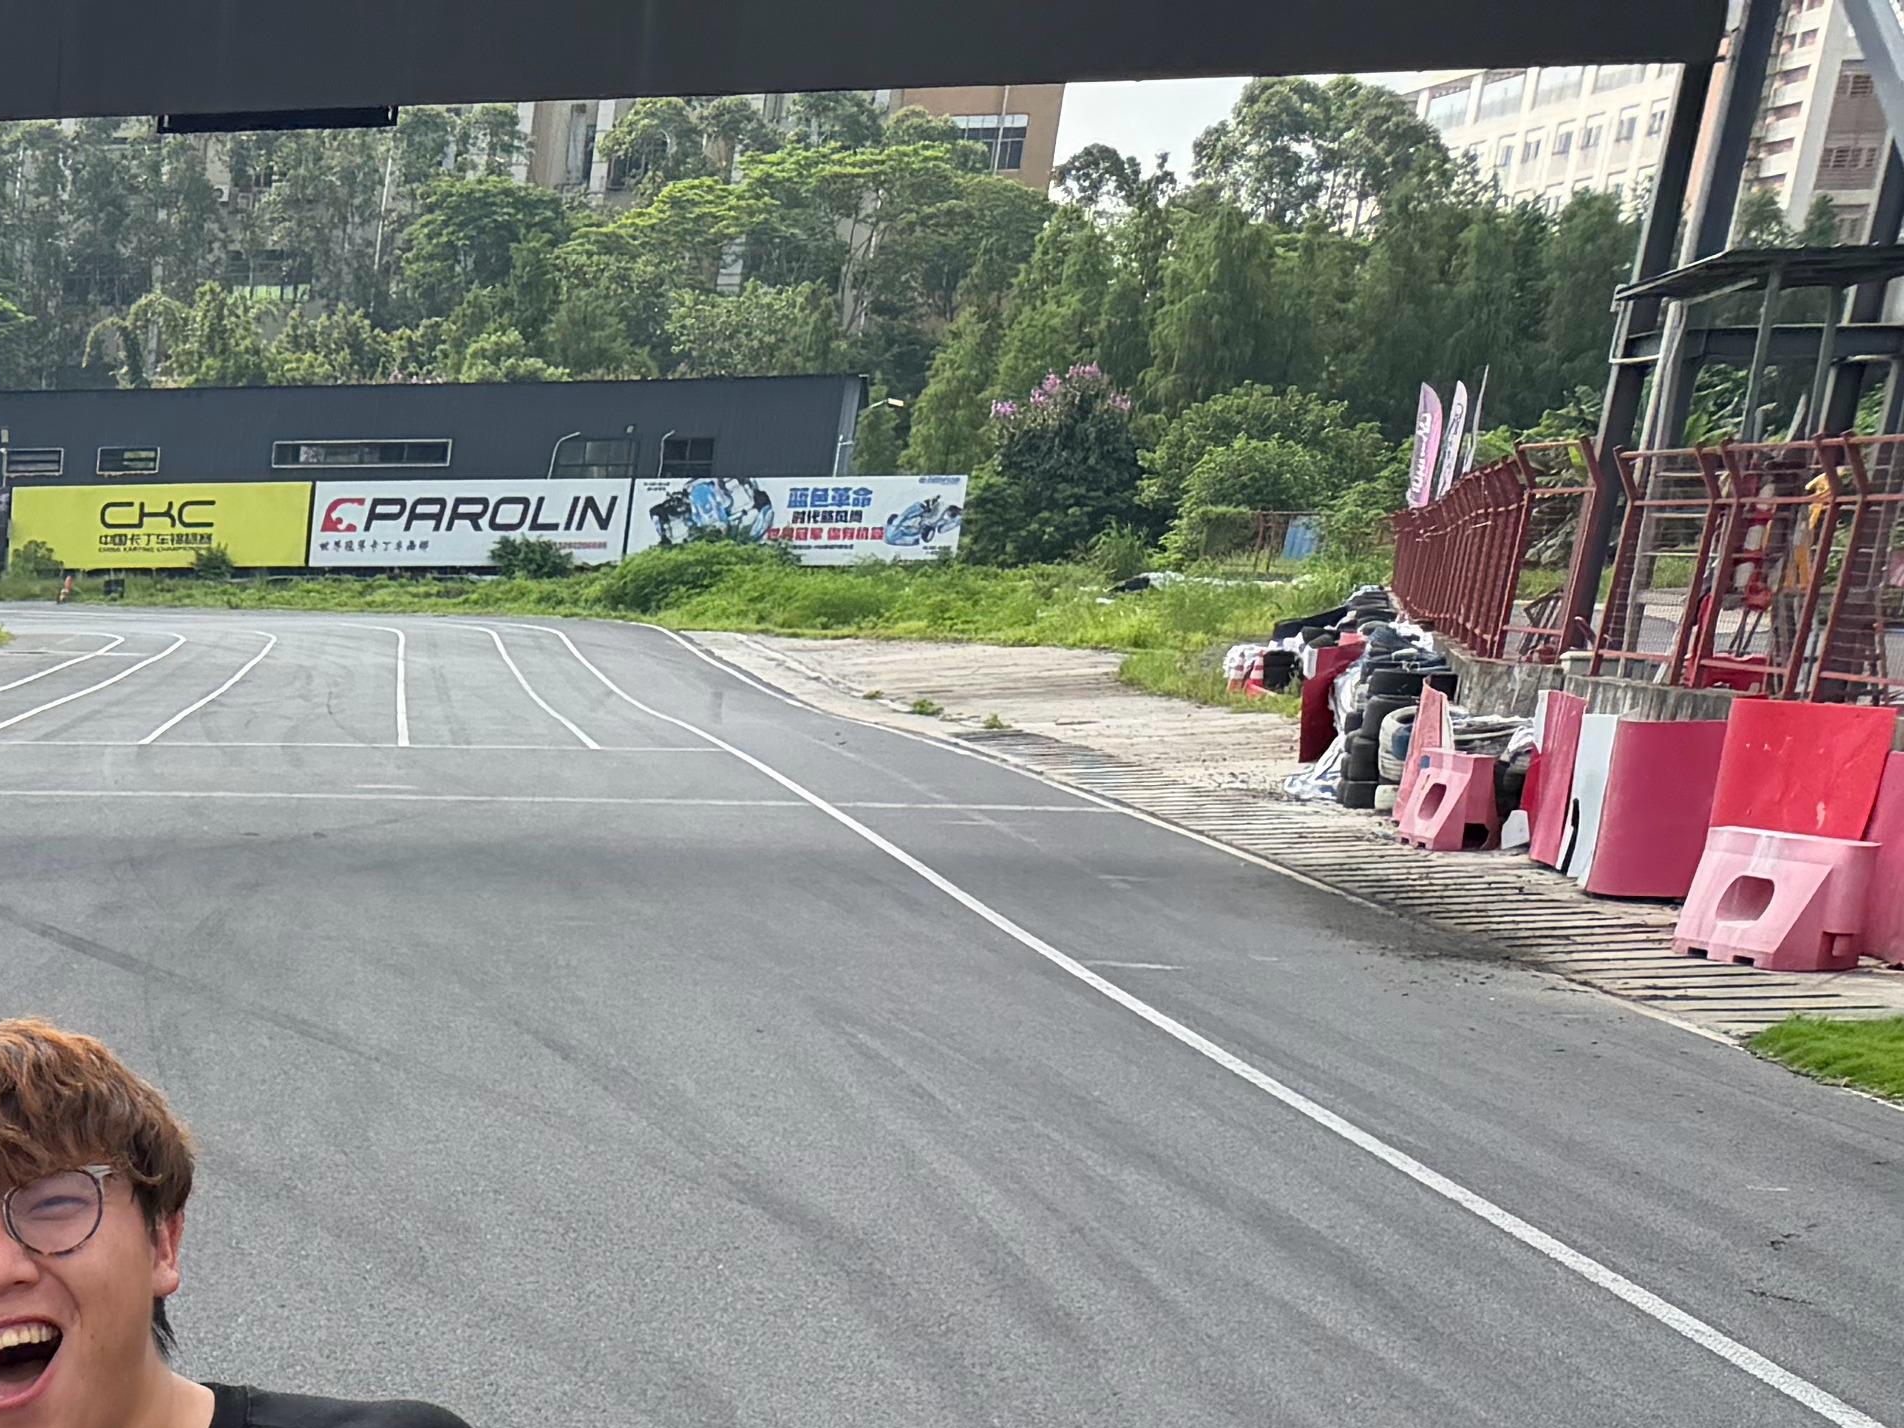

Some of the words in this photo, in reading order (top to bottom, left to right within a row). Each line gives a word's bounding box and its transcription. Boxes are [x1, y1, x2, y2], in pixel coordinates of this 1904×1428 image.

[787, 487, 873, 508] 蓝色革命
[364, 496, 618, 532] PAROLIN
